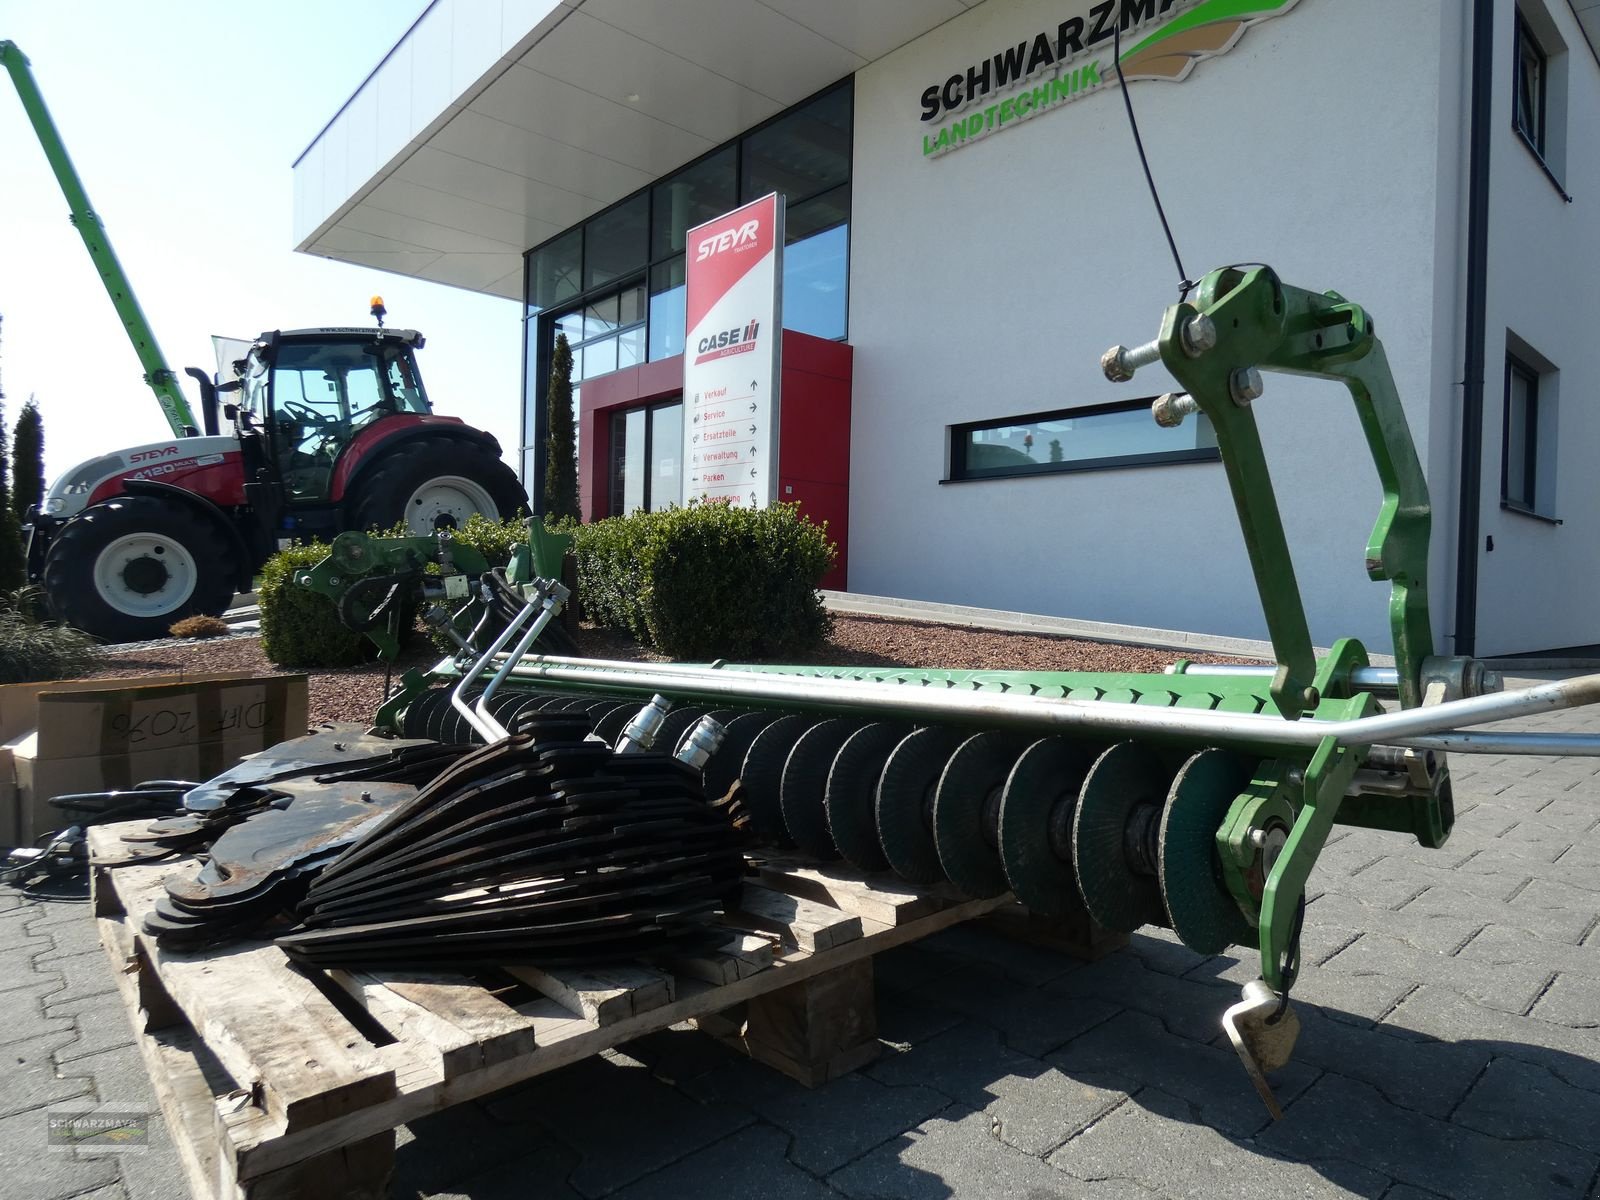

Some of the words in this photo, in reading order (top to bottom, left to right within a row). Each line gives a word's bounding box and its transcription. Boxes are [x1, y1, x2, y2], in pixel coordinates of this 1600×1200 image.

[922, 60, 1101, 157] LANDTECHNIK
[696, 220, 759, 262] STEYR
[698, 328, 740, 353] CASE
[720, 343, 754, 355] AGRICULTURE
[704, 387, 727, 399] Verkauf
[704, 410, 725, 420] Service
[704, 430, 736, 440] Ersatzteile
[129, 446, 179, 464] STEYR
[703, 450, 738, 462] Verwaltung
[134, 463, 176, 480] 4120
[703, 474, 724, 482] Parken
